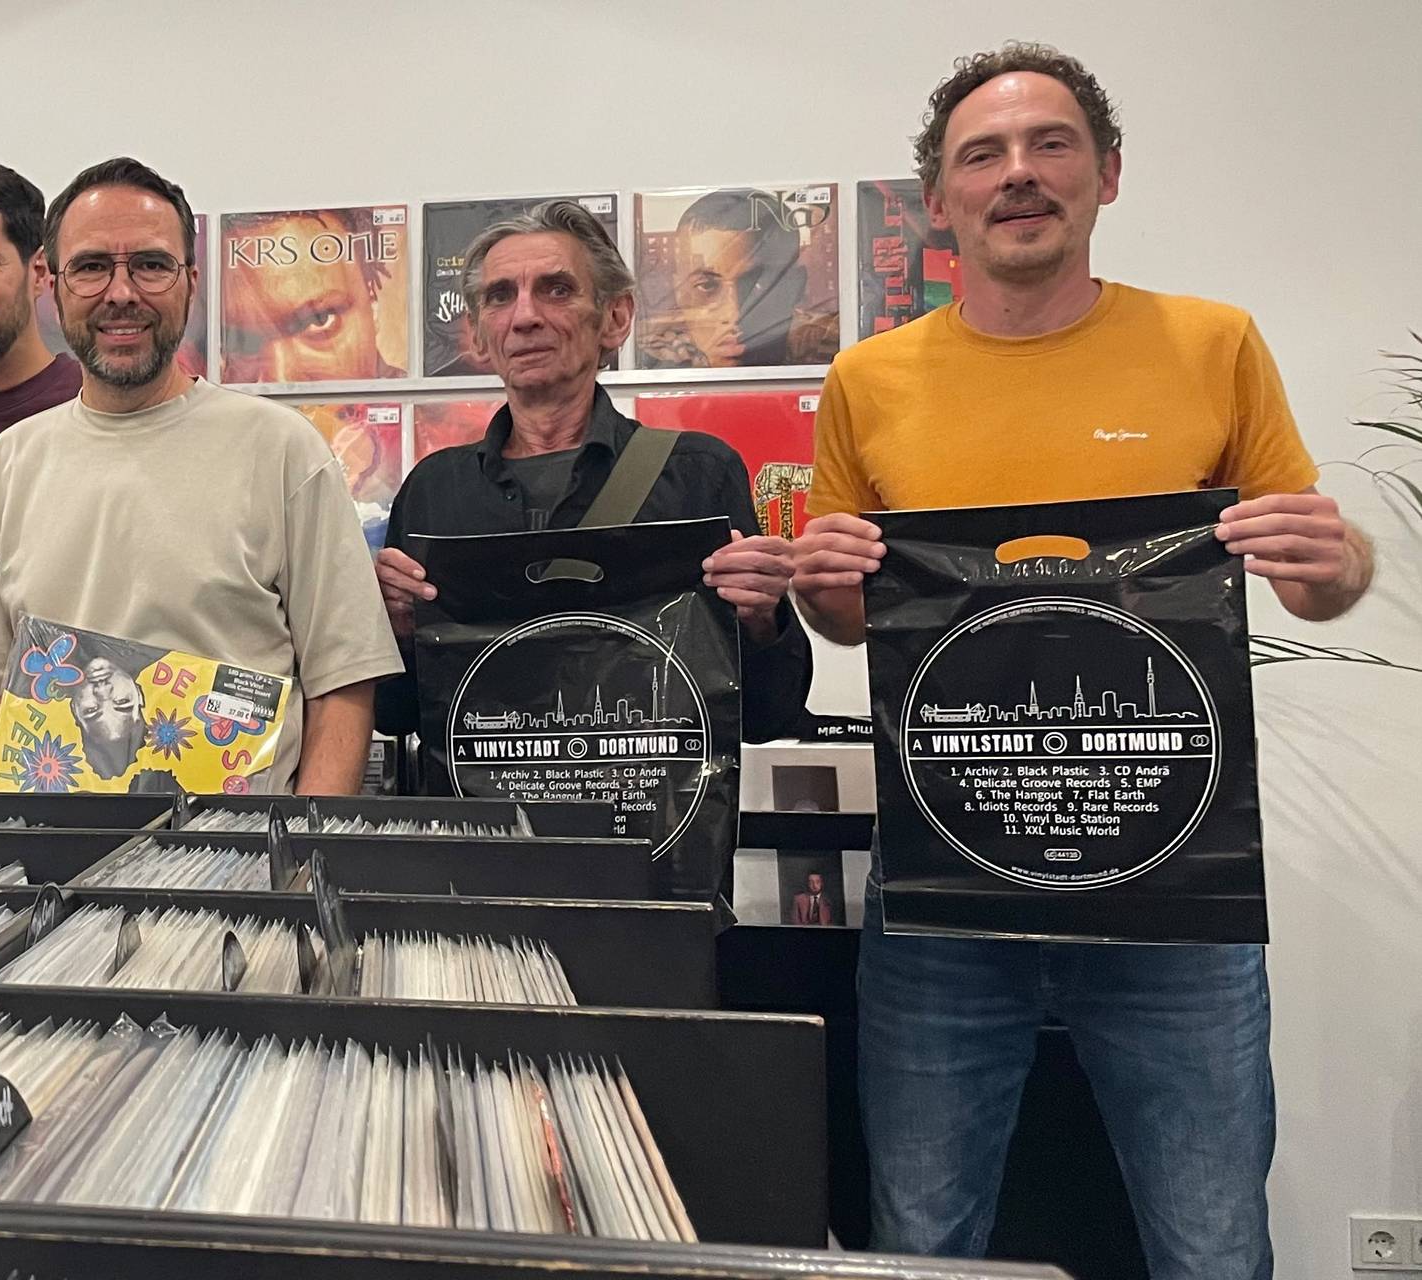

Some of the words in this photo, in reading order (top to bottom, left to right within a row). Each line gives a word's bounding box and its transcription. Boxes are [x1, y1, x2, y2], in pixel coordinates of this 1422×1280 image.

[229, 236, 298, 268] KRS
[310, 231, 398, 264] ONE
[152, 661, 197, 699] DE
[817, 725, 844, 737] MAC
[847, 724, 873, 735] MILL
[458, 744, 466, 756] A
[473, 739, 561, 758] VINYLSTADT
[599, 736, 678, 756] DORTMUND
[912, 738, 923, 751] A
[931, 734, 1035, 753] VINYLSTADT
[1081, 732, 1183, 752] DORTMUND
[489, 770, 498, 780] 1.
[501, 769, 530, 780] Archiv
[533, 770, 542, 780] 2.
[545, 769, 571, 779] Black
[574, 768, 604, 779] Plastic
[611, 768, 619, 778] 3.
[623, 767, 636, 778] CD
[950, 767, 961, 777] 1.
[964, 766, 999, 777] Archiv
[1002, 766, 1013, 777] 2.
[1017, 766, 1048, 776] Black
[1052, 765, 1090, 776] Plastic
[1098, 766, 1110, 776] 3.
[1114, 765, 1131, 776] CD
[496, 781, 505, 791] 4.
[508, 780, 545, 791] Delicate
[548, 780, 582, 791] Groove
[585, 779, 620, 790] Records
[627, 779, 636, 789] 5.
[639, 778, 659, 788] EMP
[959, 778, 970, 788] 4.
[973, 778, 1017, 788] Delicate
[1021, 778, 1062, 788] Groove
[1065, 777, 1111, 788] Records
[1120, 778, 1132, 788] 5.
[1136, 778, 1162, 788] EMP
[602, 790, 619, 800] Flat
[622, 790, 646, 800] Earth
[975, 790, 986, 800] 6.
[989, 790, 1011, 800] The
[1015, 790, 1063, 802] Hangout
[1072, 790, 1083, 800] 7.
[1087, 790, 1110, 800] Flat
[1114, 790, 1145, 800] Earth
[621, 802, 657, 812] Records
[964, 801, 975, 812] 8.
[979, 801, 1010, 812] Idiots
[1014, 801, 1058, 812] Records
[1067, 801, 1078, 812] 9.
[1082, 801, 1109, 812] Rare
[1113, 801, 1160, 812] Records
[1002, 813, 1019, 823] 10.
[1022, 813, 1050, 826] Vinyl
[1054, 814, 1076, 824] Bus
[1080, 813, 1121, 824] Station
[1004, 825, 1021, 835] 11.
[1025, 825, 1046, 835] XXL
[1049, 825, 1082, 836] Music
[1086, 825, 1120, 836] World
[1011, 865, 1120, 882] www.vinylstadt-dortmund.de
